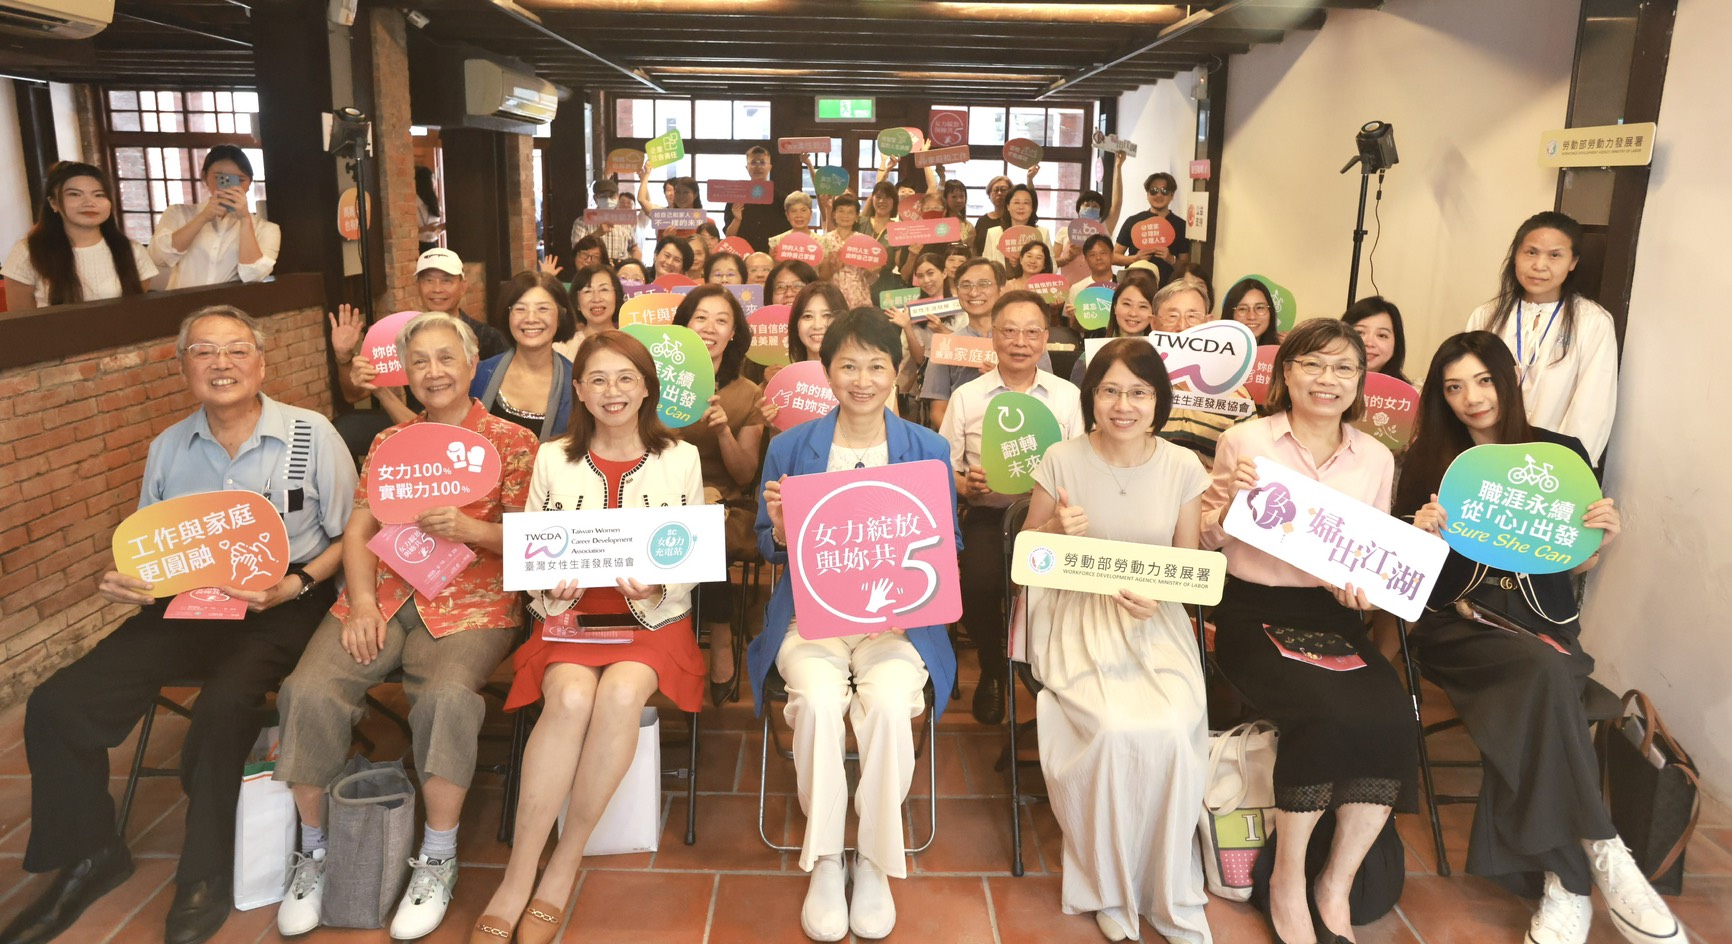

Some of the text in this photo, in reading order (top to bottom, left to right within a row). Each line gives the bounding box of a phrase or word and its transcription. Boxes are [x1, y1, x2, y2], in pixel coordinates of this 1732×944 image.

[1563, 136, 1644, 151] 勞動部勞動力發展署
[1154, 333, 1236, 356] TWCDA
[659, 385, 697, 410] 出發
[665, 404, 691, 422] Can
[1001, 434, 1038, 460] 翻轉
[378, 462, 452, 481] 女力100%
[1008, 454, 1041, 478] 未來
[378, 480, 471, 501] 實戰力100%
[1478, 480, 1576, 523] 職涯永續
[128, 503, 256, 560] 工作與家庭
[811, 512, 922, 549] 女力綻放
[1460, 498, 1580, 548] 從「心」出發
[524, 532, 562, 541] TWCDA
[592, 536, 633, 545] Development
[1448, 521, 1572, 564] Sure She Can
[136, 544, 215, 583] 更圓融
[524, 556, 635, 572] 臺灣女性生涯發展協會
[1306, 507, 1426, 601] 婦出江湖
[1063, 568, 1095, 577] WORKFORCE
[1096, 572, 1134, 581] DEVELOPMENT
[1064, 552, 1210, 582] 勞動部勞動力發展署
